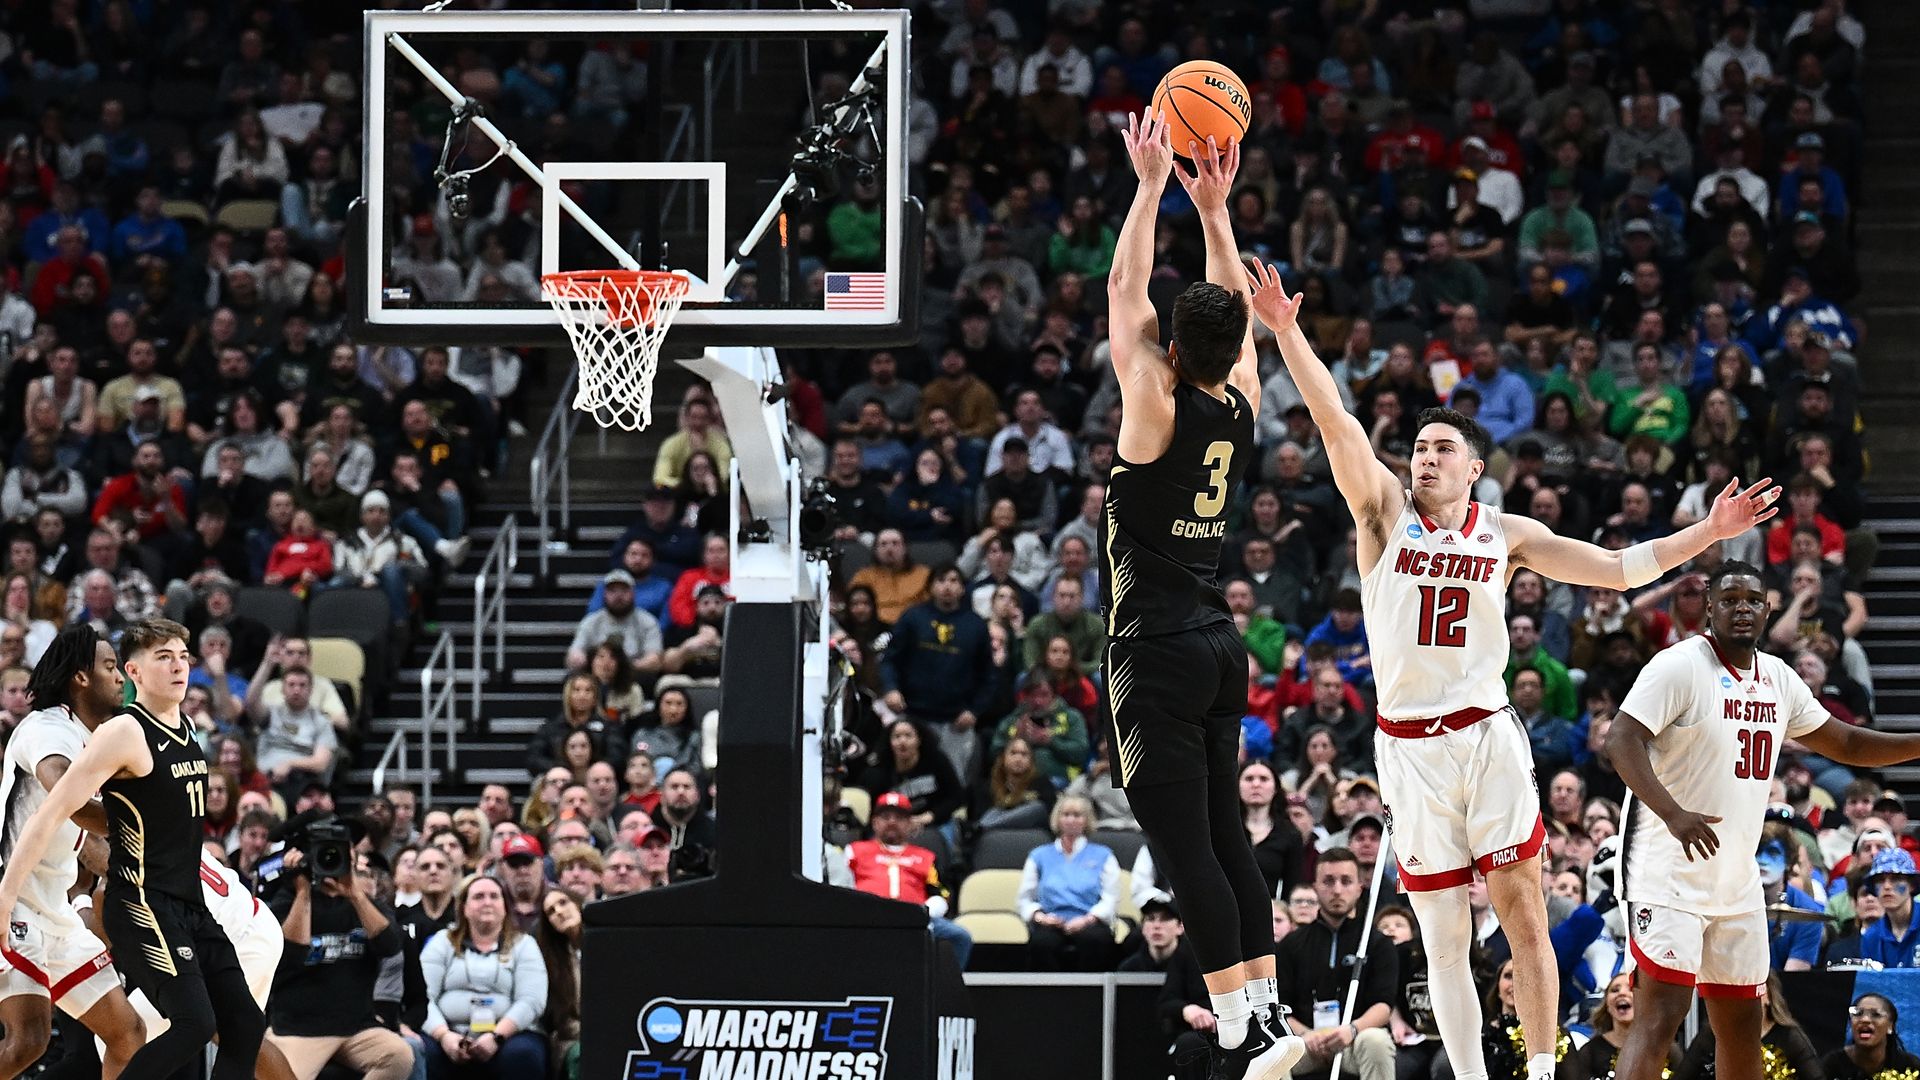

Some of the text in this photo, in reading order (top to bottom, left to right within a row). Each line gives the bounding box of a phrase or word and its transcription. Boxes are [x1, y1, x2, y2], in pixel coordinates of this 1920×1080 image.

[1204, 74, 1251, 124] Wilson
[1193, 440, 1234, 518] 3
[1171, 519, 1226, 539] GOHLKE
[1394, 547, 1498, 583] NC STATE
[1417, 584, 1471, 648] 12
[1723, 698, 1777, 723] NC STATE
[170, 759, 208, 779] OAKLAND
[1734, 728, 1773, 781] 30
[185, 779, 205, 818] 11
[1492, 846, 1519, 867] PACK
[683, 1008, 819, 1049] MARCH
[699, 1050, 882, 1080] MADNESS
